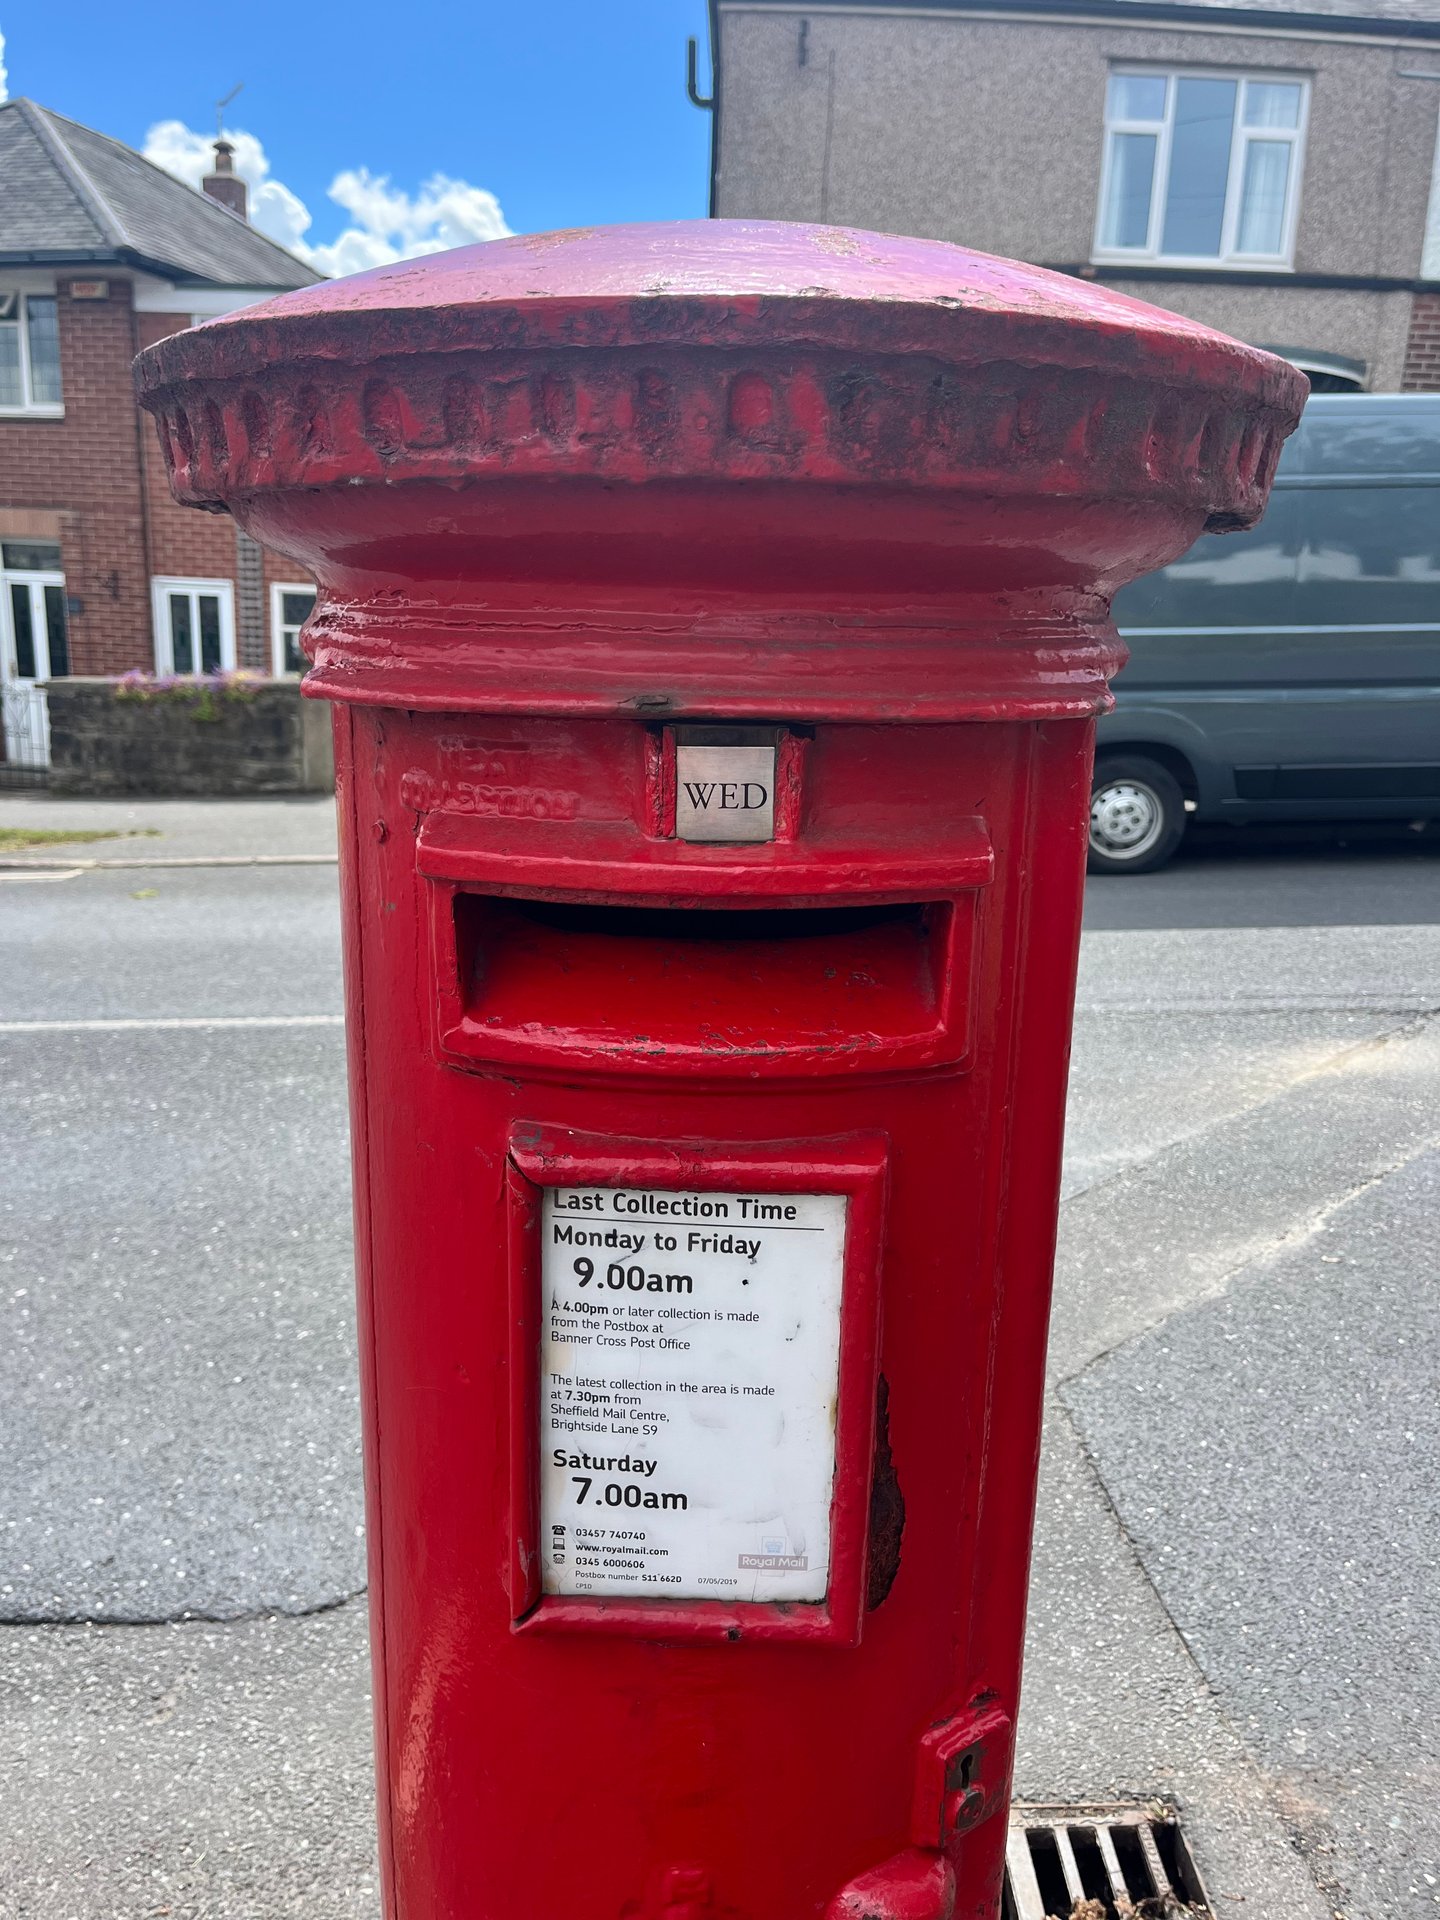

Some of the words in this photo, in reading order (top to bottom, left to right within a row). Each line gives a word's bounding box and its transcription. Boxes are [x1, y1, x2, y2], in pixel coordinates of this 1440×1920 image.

[683, 782, 767, 809] WED
[553, 1190, 604, 1211] Last
[613, 1192, 728, 1218] Collection
[736, 1198, 797, 1220] Time
[554, 1224, 645, 1254] Monday
[654, 1232, 677, 1251] to
[688, 1232, 762, 1259] Friday
[573, 1255, 693, 1294] 9.00am
[551, 1300, 561, 1311] A
[563, 1301, 608, 1316] 4.00pm
[612, 1307, 625, 1316] or
[628, 1305, 655, 1317] later
[658, 1308, 710, 1320] collection
[714, 1309, 723, 1321] is
[727, 1311, 759, 1322] made
[550, 1315, 578, 1328] from
[582, 1318, 600, 1330] the
[604, 1319, 649, 1333] Postbox
[652, 1324, 664, 1333] at
[551, 1330, 593, 1344] Banner
[596, 1334, 626, 1347] Cross
[631, 1336, 655, 1348] Post
[659, 1338, 690, 1350] Office
[550, 1373, 572, 1386] The
[576, 1376, 606, 1388] latest
[609, 1379, 662, 1391] collection
[666, 1381, 676, 1392] in
[680, 1382, 698, 1393] the
[701, 1385, 727, 1394] area
[730, 1384, 739, 1394] is
[743, 1385, 775, 1396] made
[550, 1390, 562, 1400] at
[565, 1390, 610, 1404] 7.30pm
[614, 1393, 641, 1405] from
[550, 1403, 599, 1417] Sheffield
[603, 1408, 626, 1419] Mail
[630, 1409, 669, 1422] Centre,
[551, 1418, 607, 1432] Brightside
[611, 1423, 639, 1434] Lane
[642, 1424, 658, 1435] S9
[553, 1449, 657, 1477] Saturday
[572, 1477, 687, 1511] 7.00am
[576, 1528, 606, 1538] 03457
[609, 1530, 646, 1540] 740740
[575, 1544, 668, 1556] www.royalmail.com
[576, 1557, 599, 1566] 0345
[603, 1559, 645, 1569] 6000606
[741, 1555, 776, 1569] Royal
[779, 1556, 805, 1568] Mail
[575, 1570, 606, 1579] Postbox
[642, 1574, 659, 1582] S11
[698, 1577, 738, 1585] 07/05/2019
